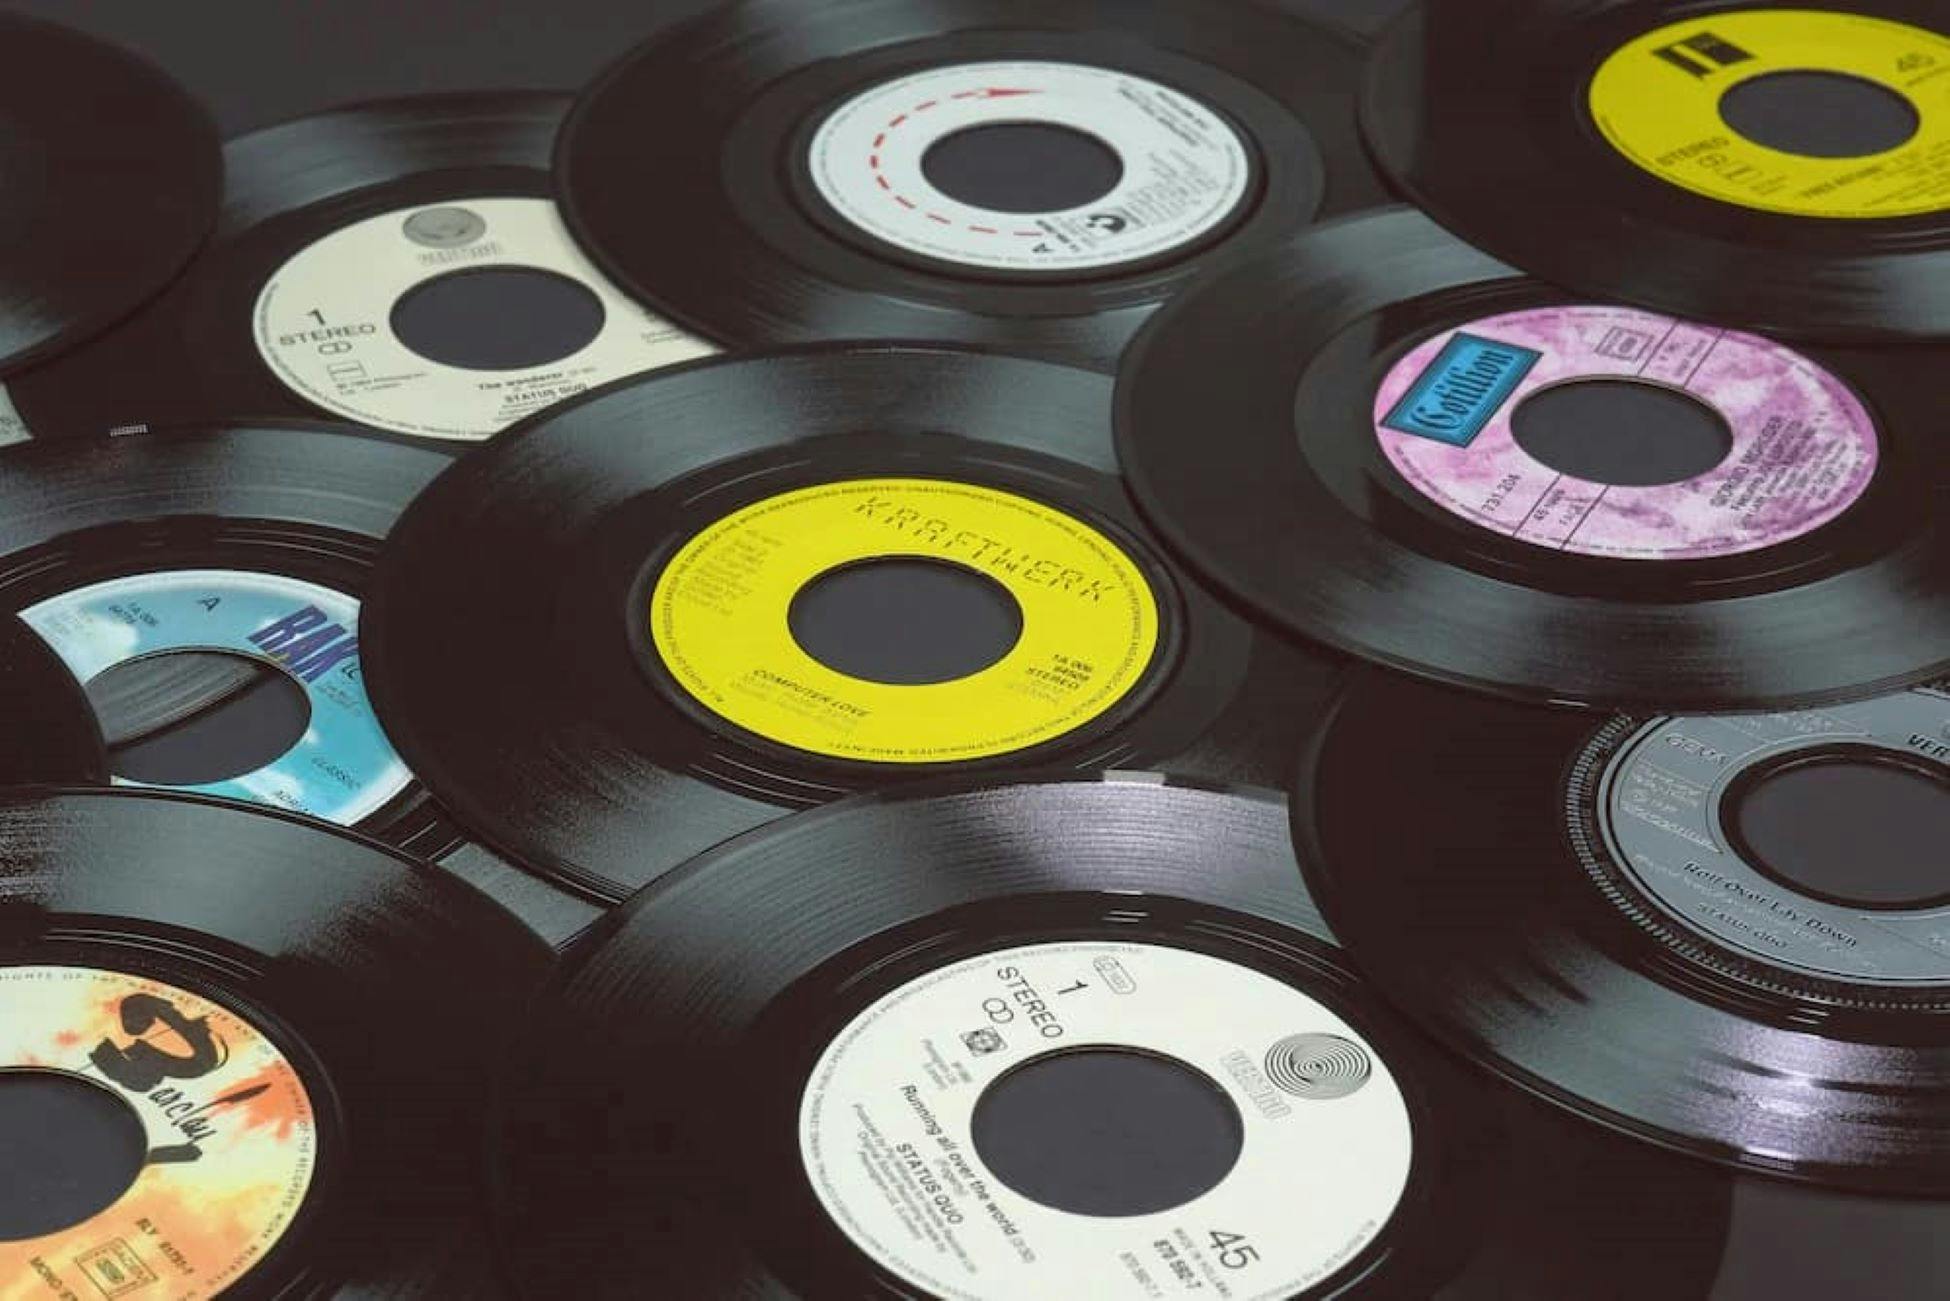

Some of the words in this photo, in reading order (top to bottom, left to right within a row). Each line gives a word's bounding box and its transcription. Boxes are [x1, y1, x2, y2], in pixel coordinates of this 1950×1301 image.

[279, 324, 377, 346] STEREO
[306, 308, 325, 325] 1
[1410, 350, 1514, 430] Cotillion
[855, 496, 1115, 602] KRAFTWERK
[198, 597, 222, 612] A
[753, 670, 832, 703] COMPUTER
[831, 701, 872, 717] LOVE
[1026, 667, 1079, 689] STEREO
[1683, 862, 1724, 885] Roll
[1724, 880, 1767, 905] Over
[1805, 917, 1857, 948] Down
[997, 966, 1064, 1038] STEREO
[1057, 980, 1088, 996] 1
[900, 1084, 942, 1136] Running
[937, 1136, 960, 1152] all
[949, 1153, 976, 1180] over
[970, 1180, 990, 1201] the
[985, 1202, 1019, 1236] world
[896, 1143, 942, 1195] STATUS
[934, 1194, 965, 1225] QUO
[1208, 1230, 1261, 1269] 45
